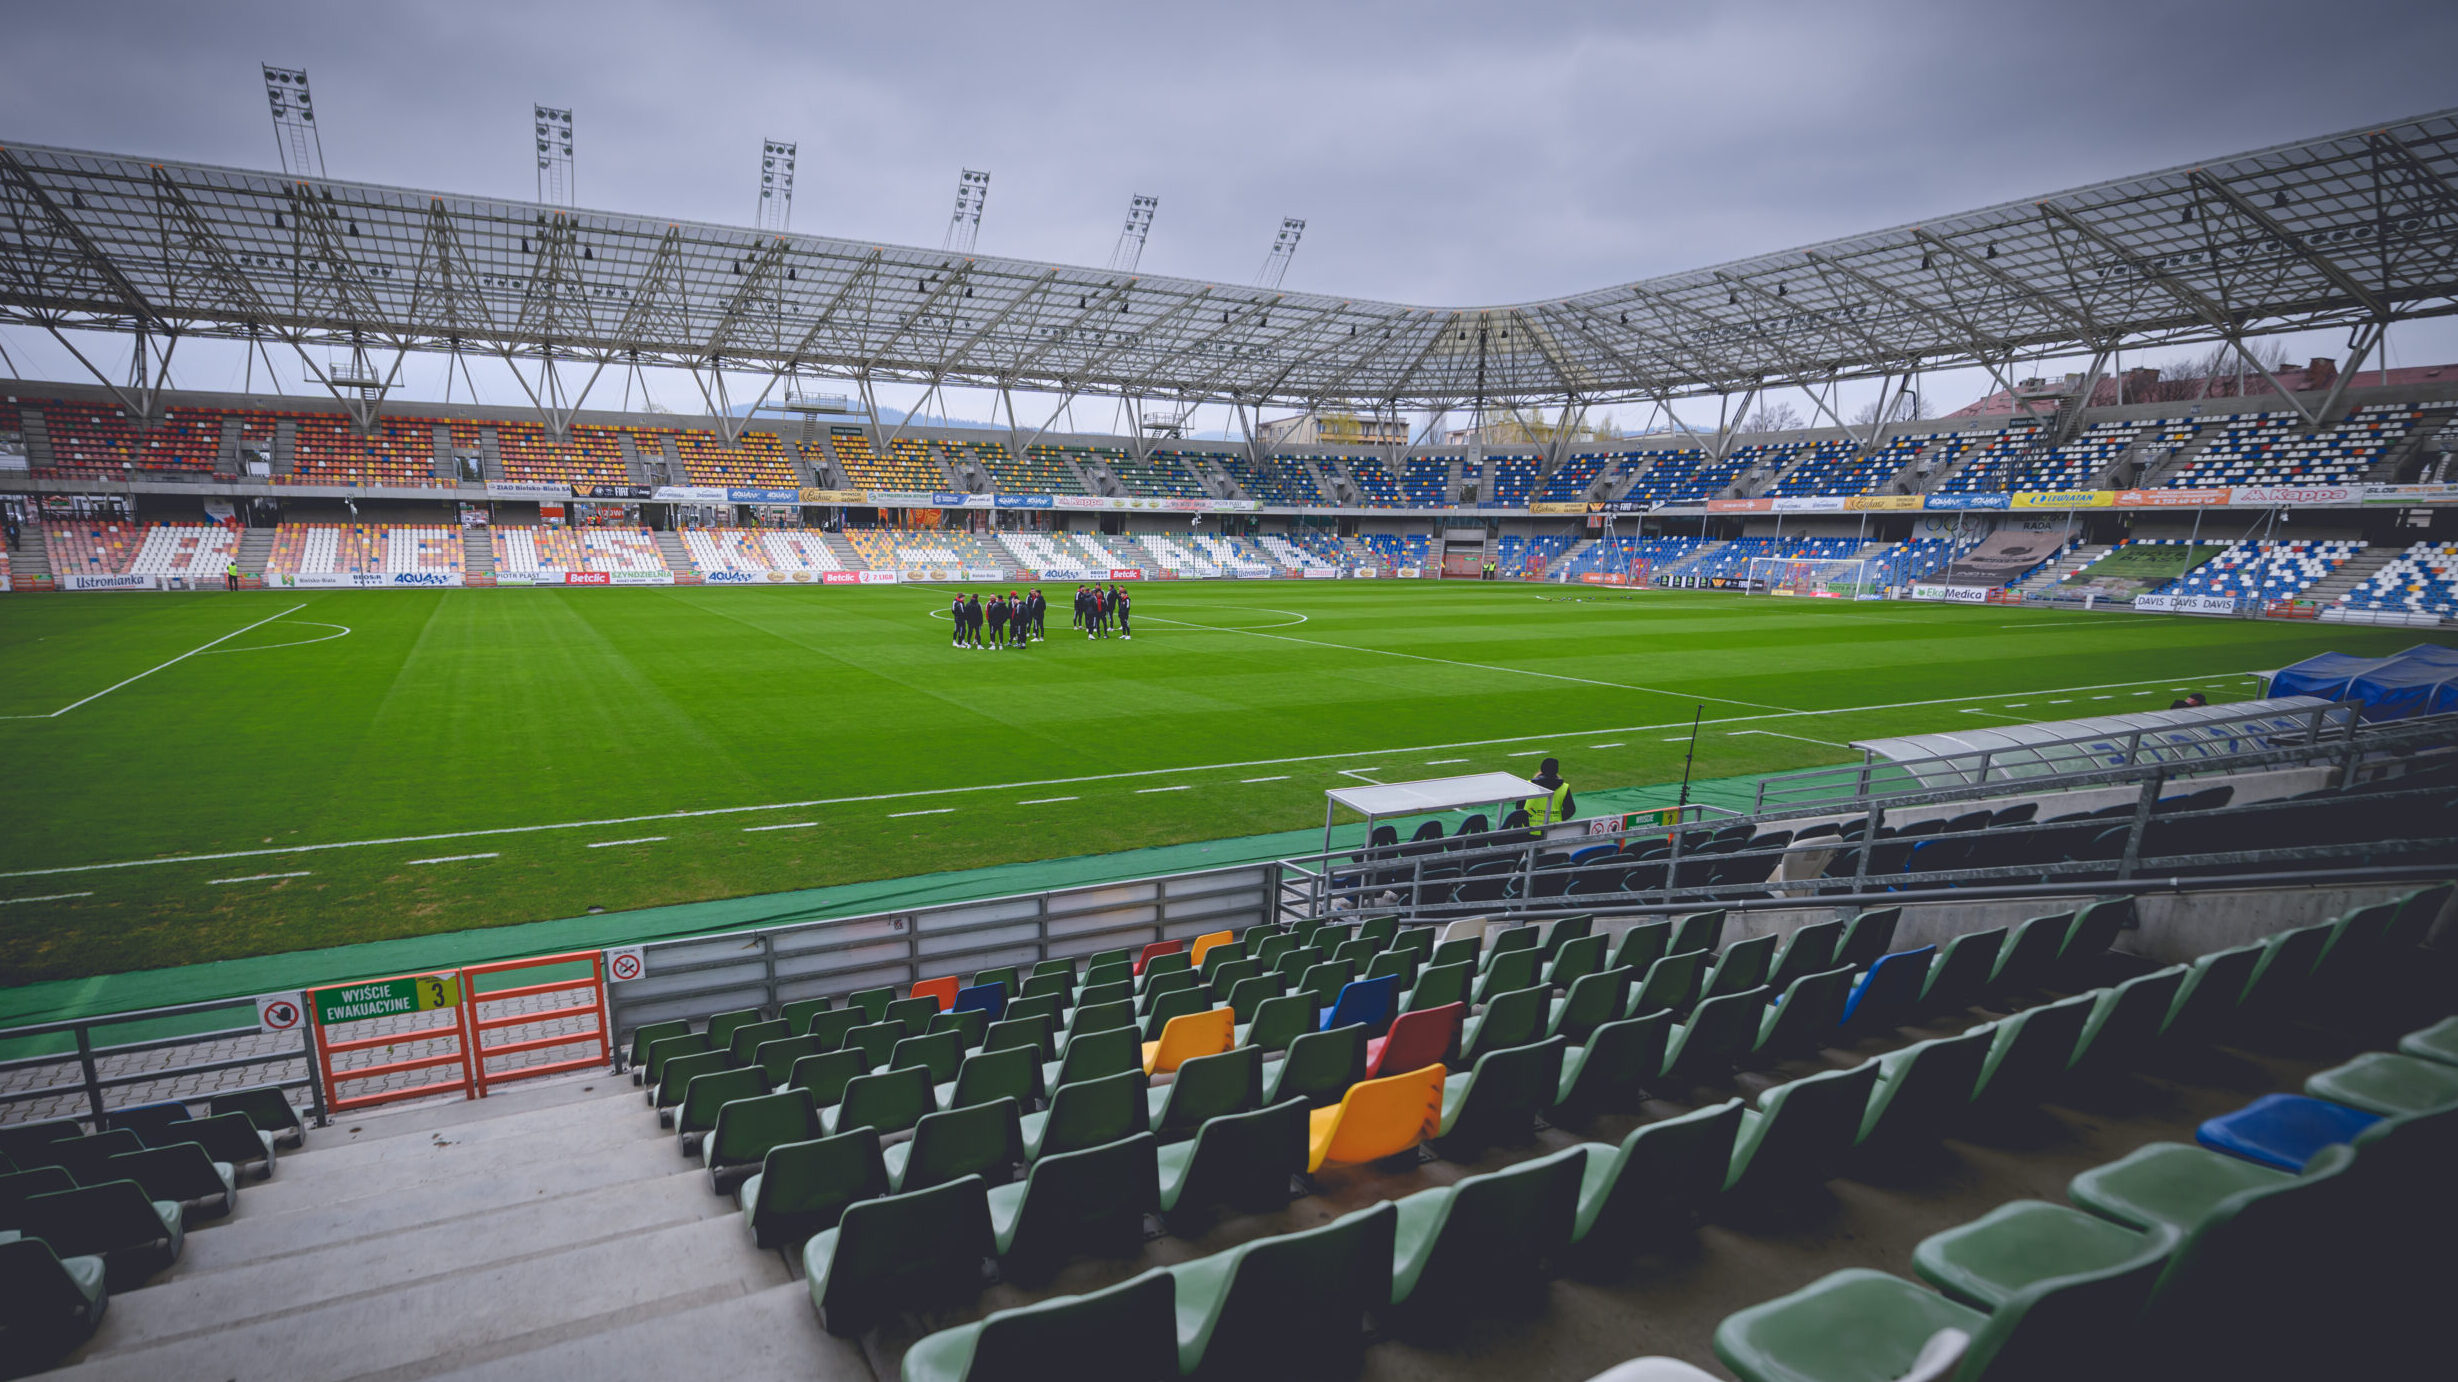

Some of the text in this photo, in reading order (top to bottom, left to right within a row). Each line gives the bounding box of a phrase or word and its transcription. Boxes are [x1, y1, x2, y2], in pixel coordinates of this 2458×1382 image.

[615, 486, 629, 497] FIAT
[2269, 489, 2348, 502] Kappa
[1620, 502, 1632, 511] FIAT
[2023, 521, 2052, 530] RADA
[394, 573, 432, 584] AQUA
[570, 573, 605, 584] Betclic
[611, 571, 672, 579] SZYNDZIELNIA
[709, 572, 740, 581] AQUA
[827, 573, 855, 582] Betclic
[1045, 570, 1068, 578] AQUA
[1113, 570, 1137, 578] Betclic
[76, 574, 144, 588] Ustronianka
[1926, 588, 1982, 599] EkoMedica
[2138, 596, 2232, 609] DAVIS DAVIS DAVIS
[341, 985, 392, 1003] WYJŚCIE
[431, 983, 445, 1007] 3
[326, 997, 411, 1020] EWAKUACYJNE
